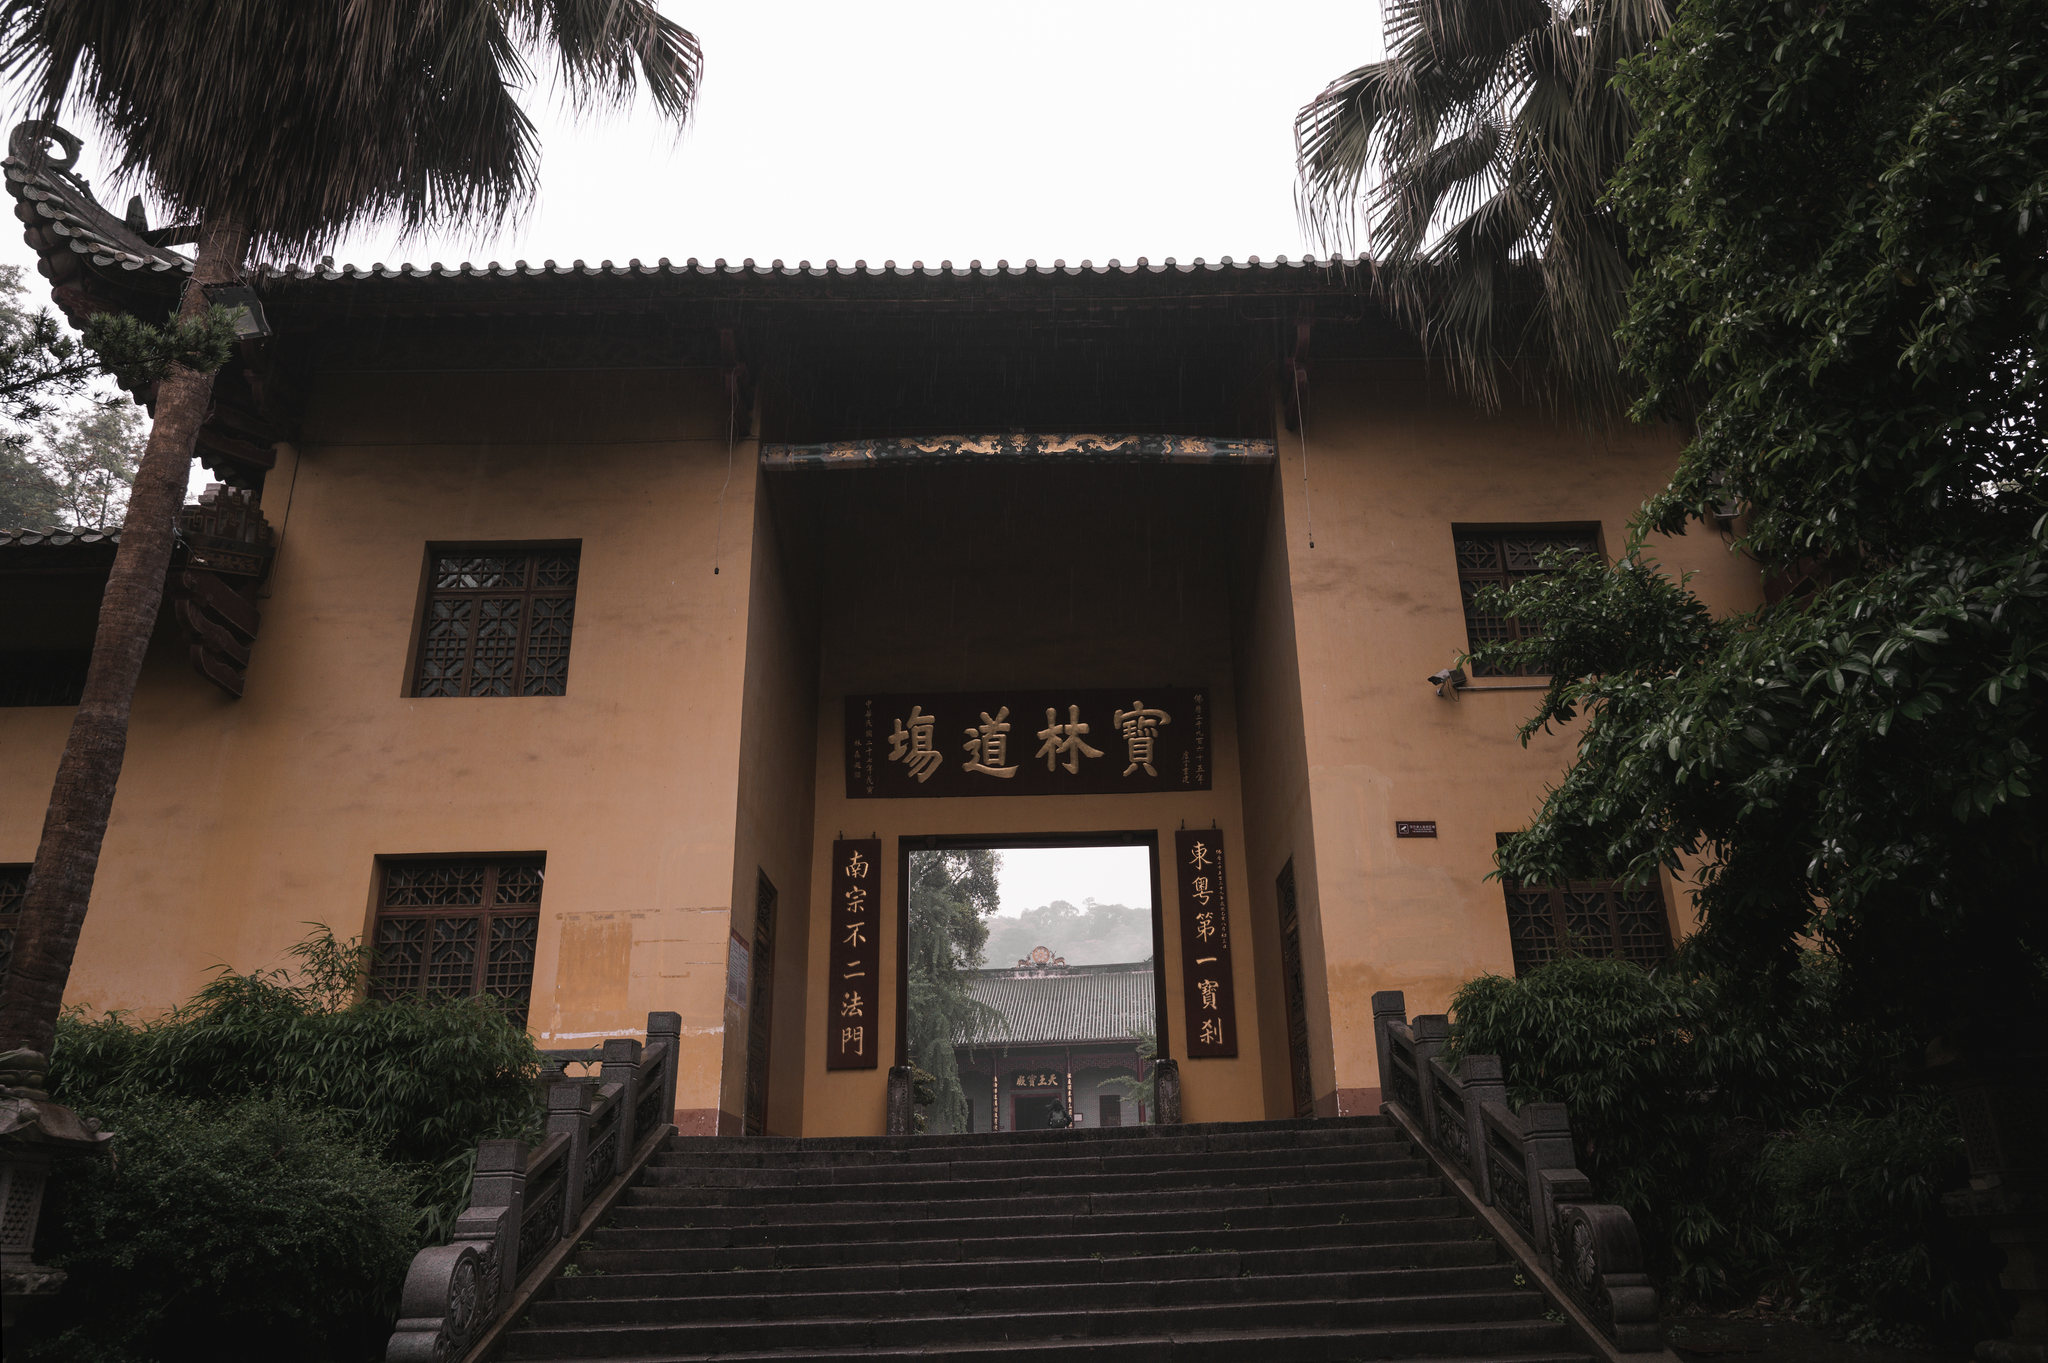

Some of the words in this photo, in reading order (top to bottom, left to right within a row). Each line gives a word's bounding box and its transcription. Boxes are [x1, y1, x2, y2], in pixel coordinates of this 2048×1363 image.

[840, 850, 869, 1056] 南宗不二法門
